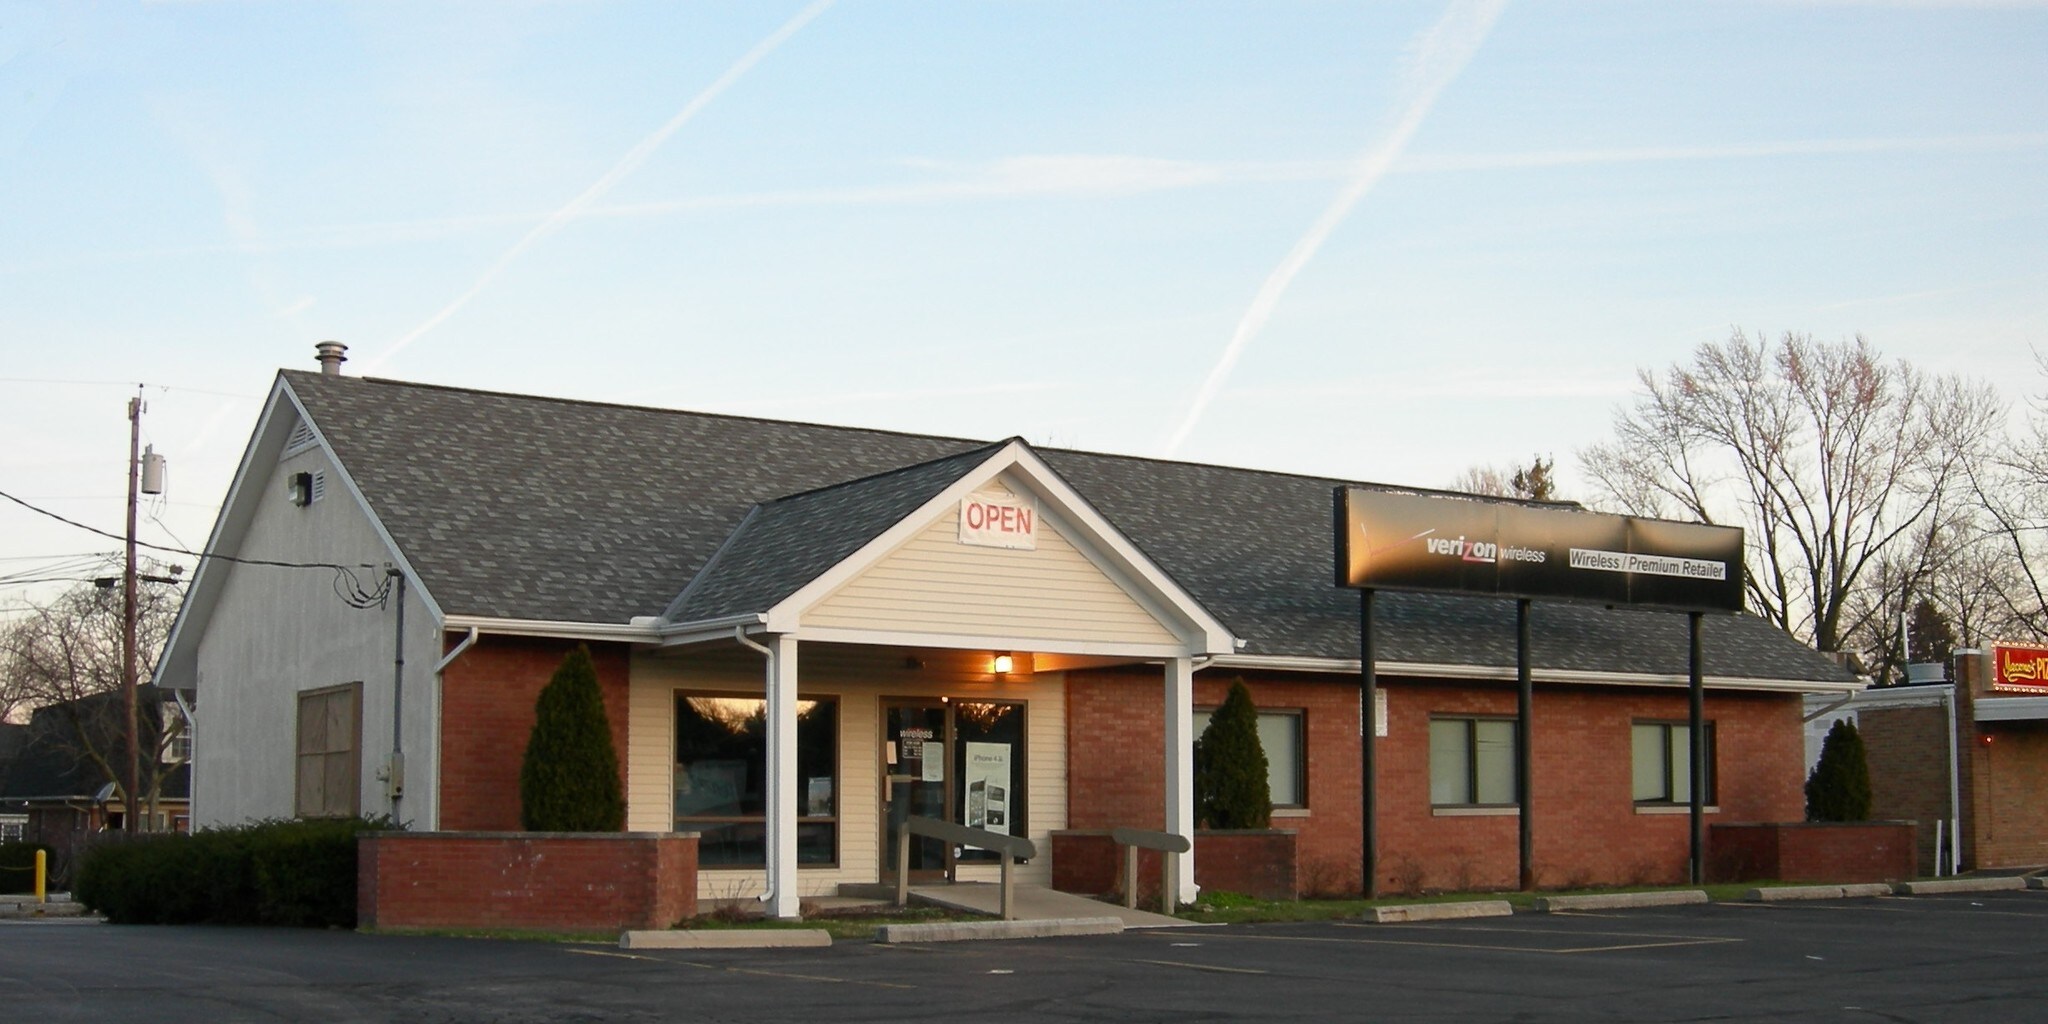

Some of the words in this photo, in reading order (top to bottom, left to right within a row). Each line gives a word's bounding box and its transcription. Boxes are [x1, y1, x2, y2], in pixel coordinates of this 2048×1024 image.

[967, 503, 1031, 534] OPEN
[1427, 536, 1496, 562] verizon
[1500, 545, 1546, 563] wireless
[1571, 551, 1620, 569] Wireless
[1629, 556, 1679, 574] Premium
[1682, 561, 1723, 578] Retailer
[899, 729, 933, 739] wireless
